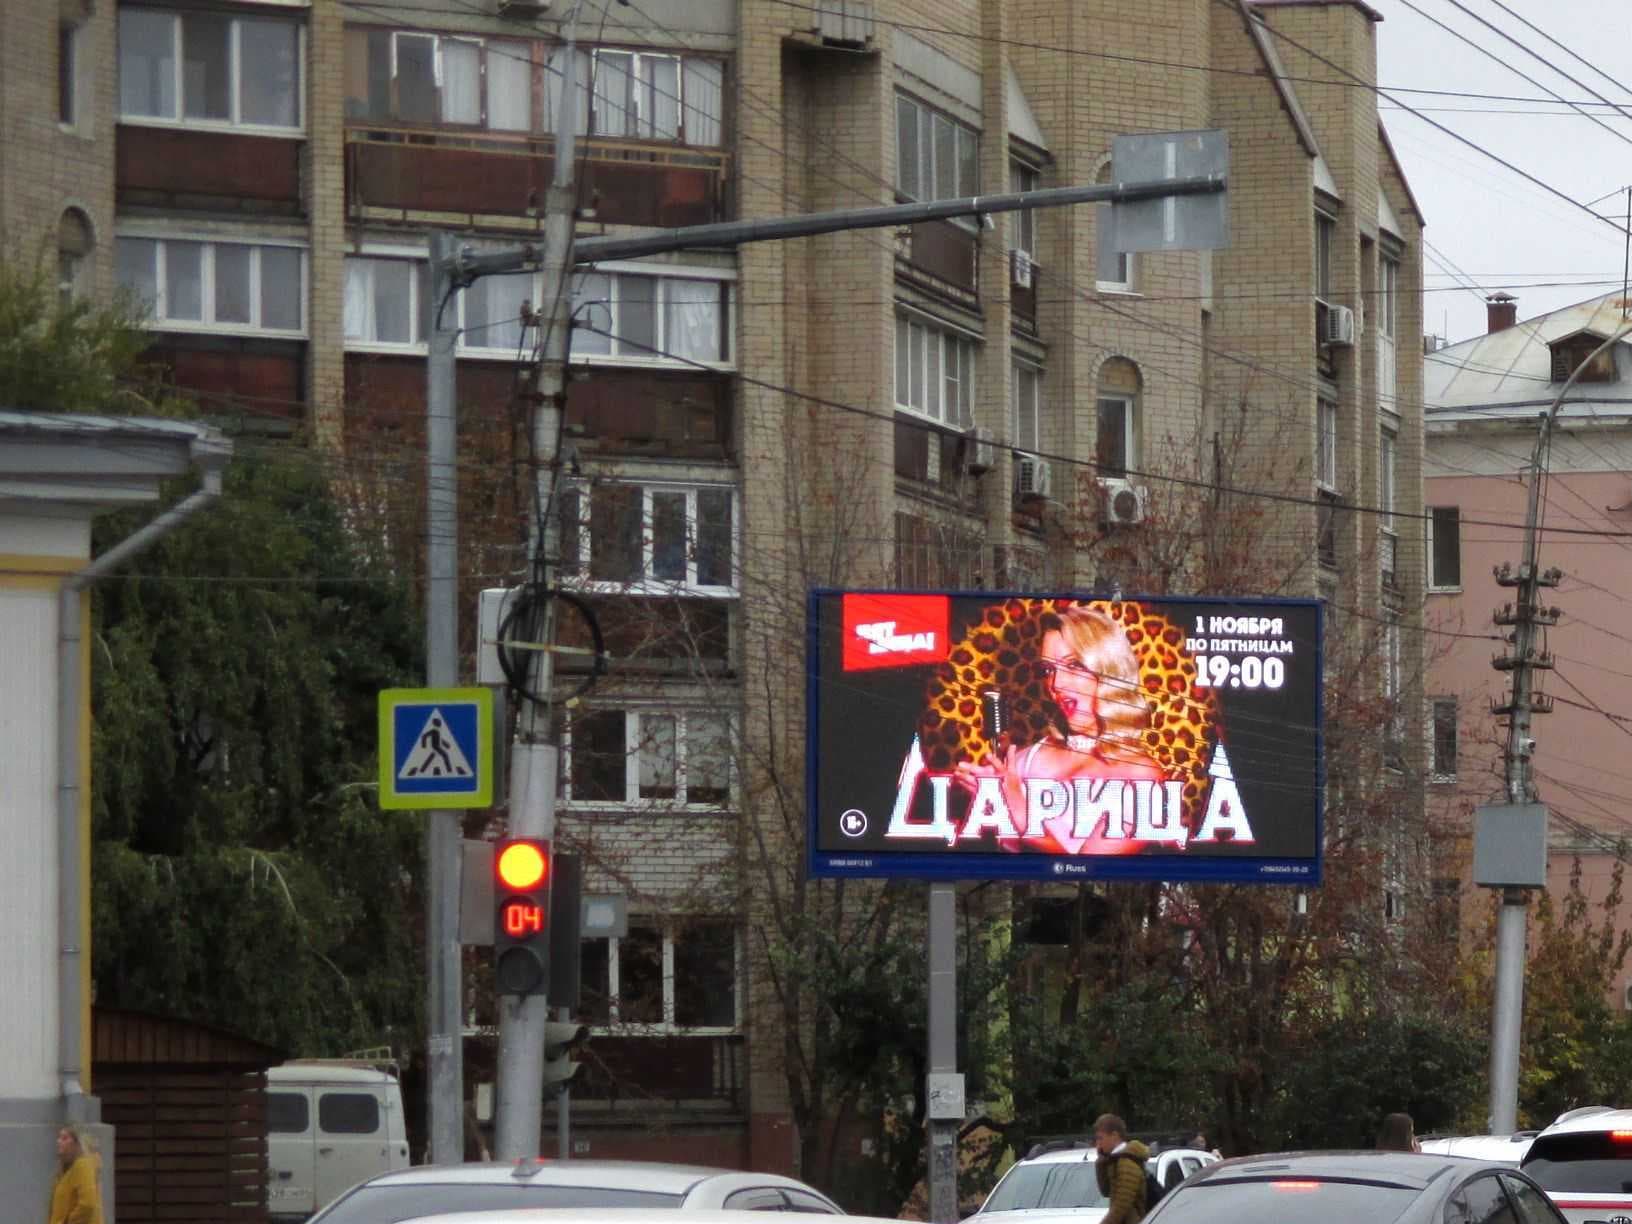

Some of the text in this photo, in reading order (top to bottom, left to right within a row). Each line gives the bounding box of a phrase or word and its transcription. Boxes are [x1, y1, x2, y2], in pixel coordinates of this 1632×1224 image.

[1195, 615, 1284, 635] 1 НОЯБРЯ
[1186, 638, 1294, 653] ПО ПЯТНИЦАМ
[1195, 655, 1285, 688] 19:00
[884, 732, 1256, 850] ЦАРИЦА
[507, 904, 540, 933] 04
